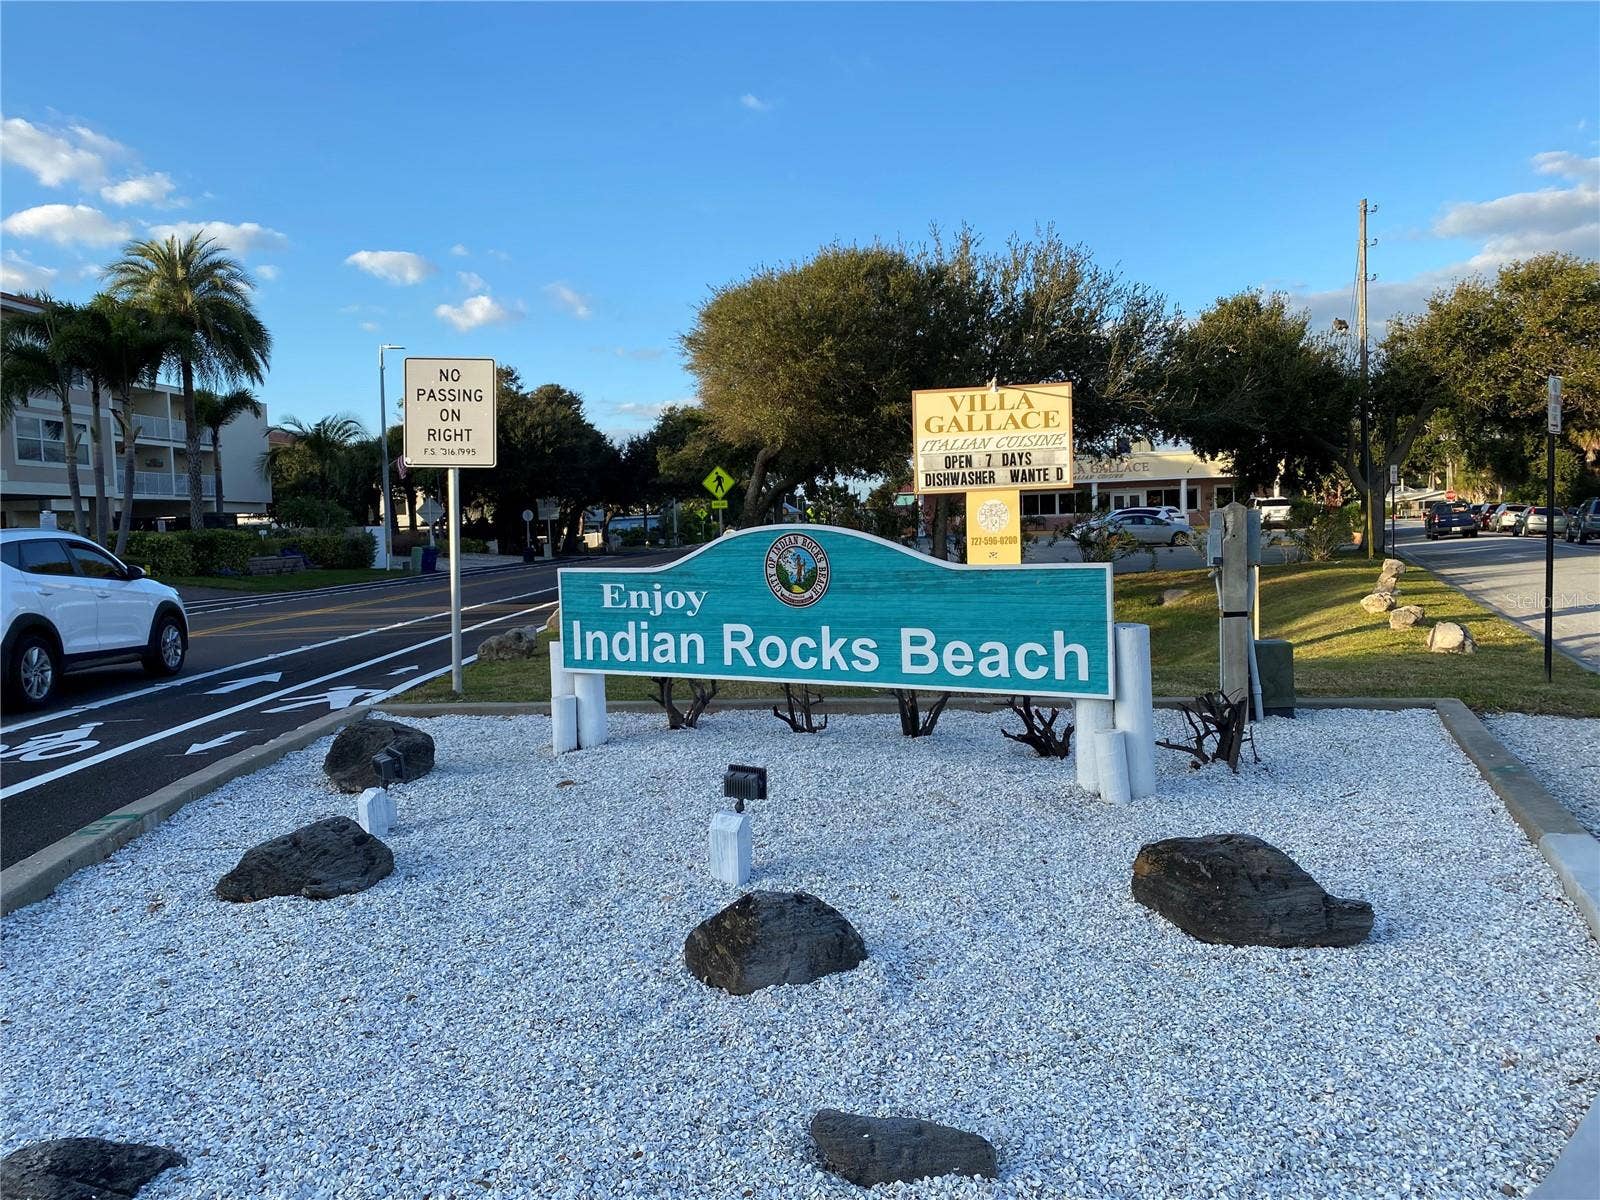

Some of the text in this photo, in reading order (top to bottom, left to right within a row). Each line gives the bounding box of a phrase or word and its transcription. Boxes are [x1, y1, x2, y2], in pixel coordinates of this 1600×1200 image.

[439, 368, 461, 382] NO
[416, 388, 483, 402] PASSING
[948, 391, 1035, 413] VILLA
[439, 408, 461, 422] ON
[924, 410, 1061, 434] GALLACE
[427, 428, 473, 442] RIGHT
[920, 432, 1067, 452] ITALIAN CUISINE
[944, 452, 1032, 470] OPEN 7 DAYS
[924, 470, 996, 487] DISHWASHER
[767, 536, 827, 597] CITY OF INDIAN ROCKS BEACH
[600, 583, 709, 617] Enjoy
[571, 619, 1091, 682] Indian Rocks Beach
